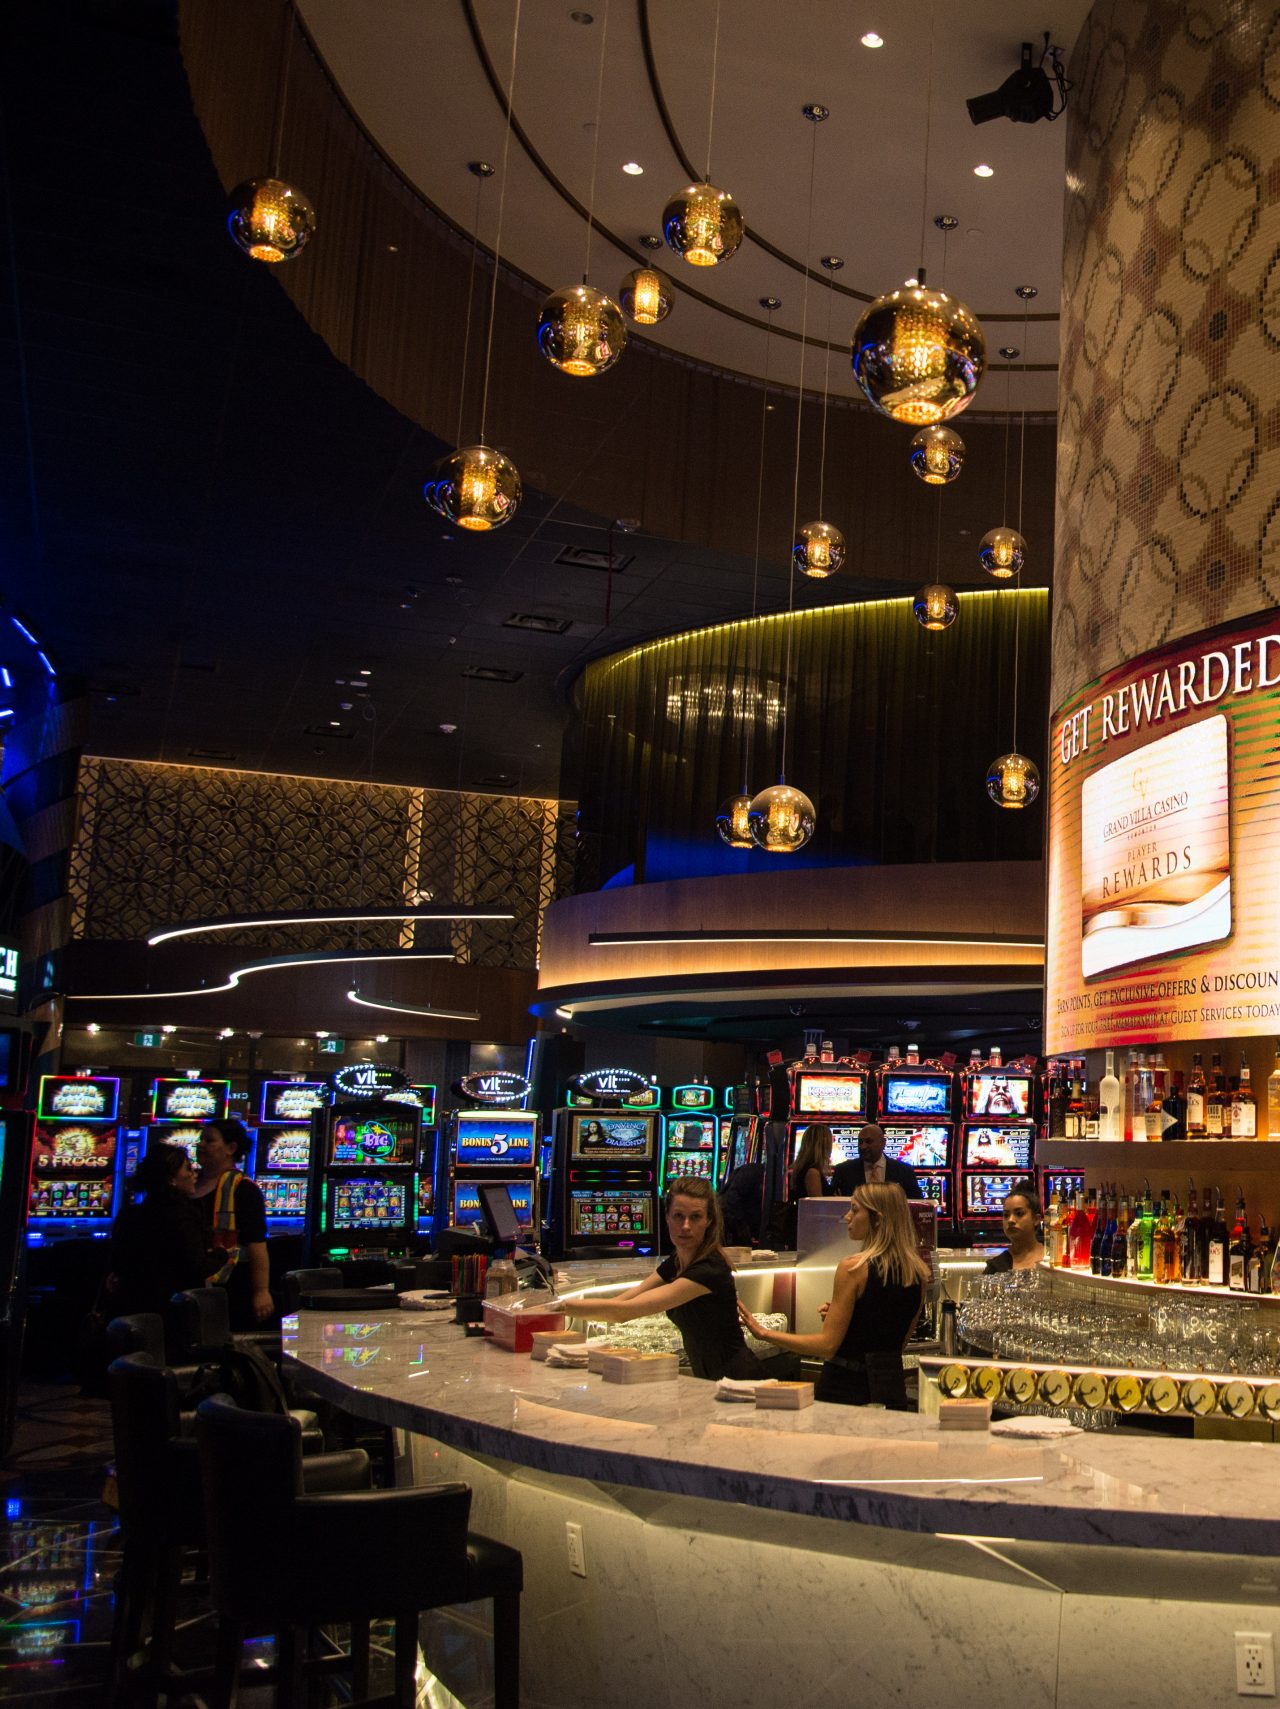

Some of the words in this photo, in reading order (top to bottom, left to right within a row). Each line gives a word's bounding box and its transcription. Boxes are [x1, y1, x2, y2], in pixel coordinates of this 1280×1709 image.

[1061, 705, 1093, 764] GET
[1104, 815, 1128, 837] GRAND
[1130, 805, 1152, 825] VILLA
[1154, 791, 1188, 815] CASINO
[1128, 842, 1157, 862] PLAYER
[1102, 845, 1191, 898] REWARDS
[1094, 990, 1107, 1006] GET
[1110, 983, 1155, 1004] EXCLUSIVE
[1158, 977, 1196, 998] OFFERS
[1201, 975, 1211, 993] &
[1171, 1010, 1197, 1024] GUEST
[1200, 1006, 1242, 1022] SERVICES
[364, 1133, 388, 1146] BIG
[462, 1137, 492, 1147] BONUS
[490, 1134, 509, 1155] 5
[508, 1138, 529, 1147] LINE
[604, 1137, 646, 1147] DIAMONDS
[38, 1155, 48, 1167] 5
[52, 1155, 108, 1167] FROGS
[460, 1199, 481, 1209] BON
[512, 1199, 528, 1208] INE
